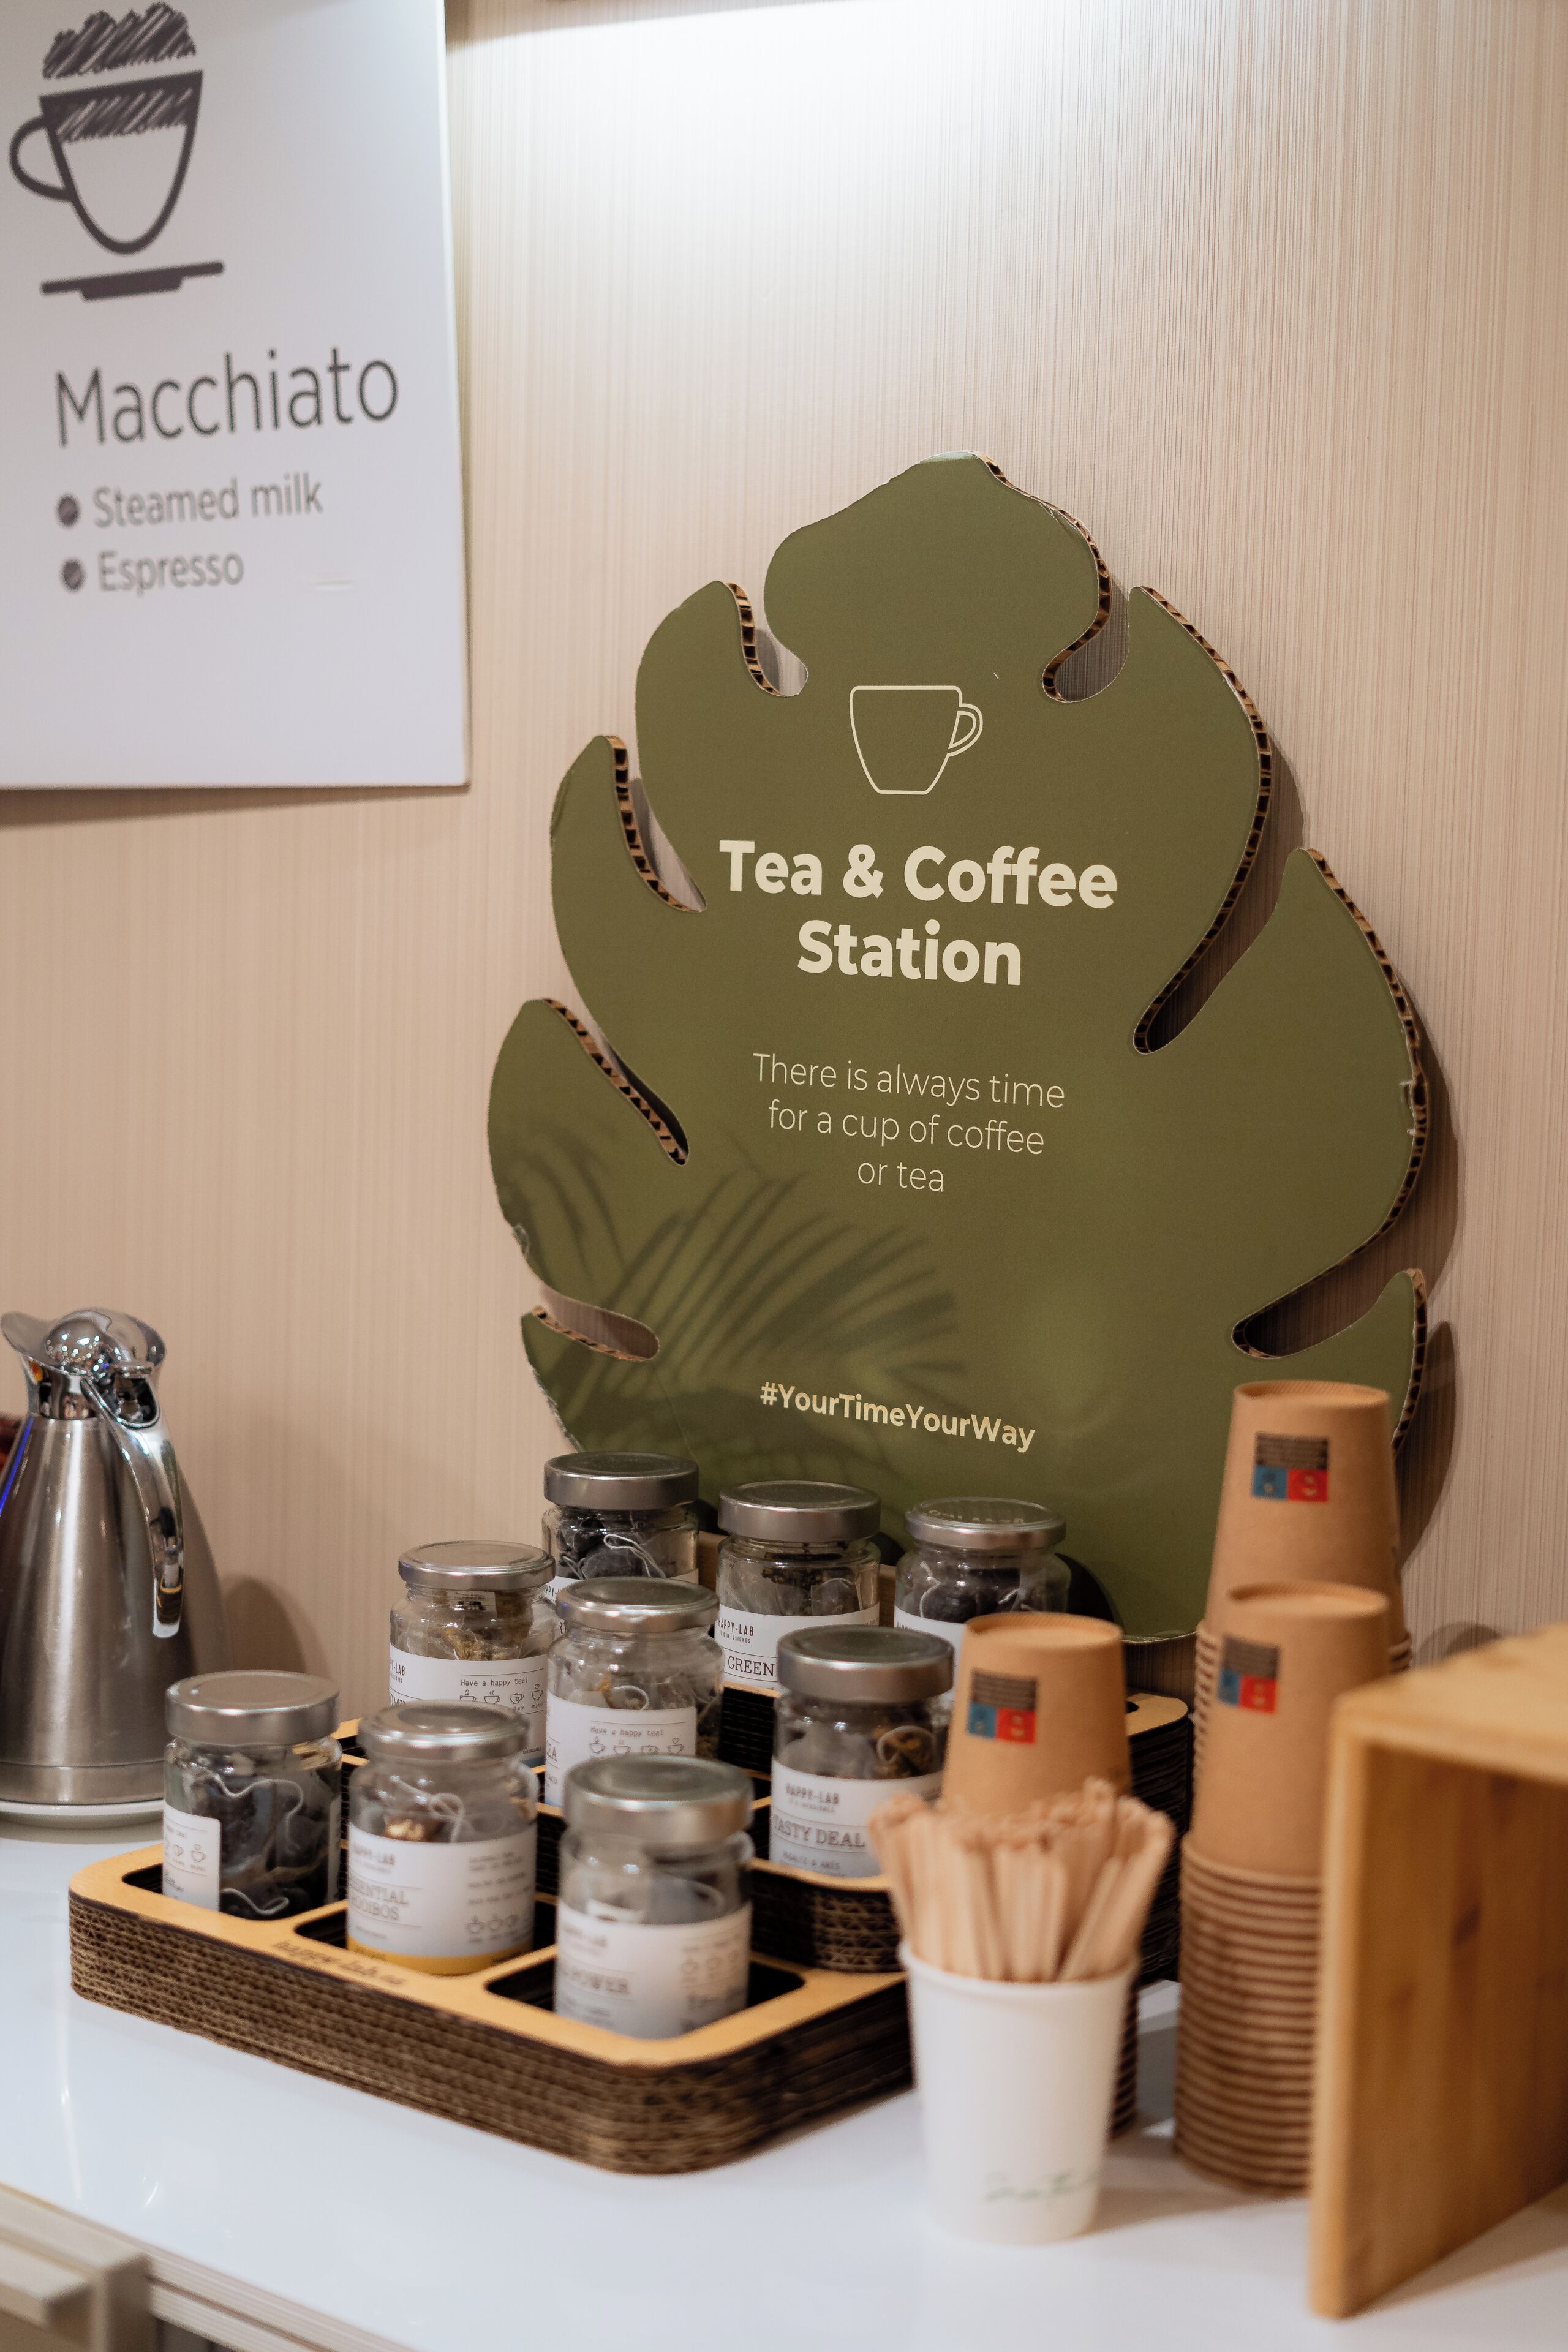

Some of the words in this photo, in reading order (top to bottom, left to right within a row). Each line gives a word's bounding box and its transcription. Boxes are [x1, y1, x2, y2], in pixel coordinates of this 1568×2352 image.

[56, 347, 399, 448] Macchiato
[93, 477, 240, 529] Steamed
[251, 472, 323, 518] milk
[97, 550, 244, 597] Espresso
[719, 839, 823, 895] Tea
[843, 843, 884, 899] &
[904, 845, 1118, 909] Coffee
[797, 919, 1021, 986] Station
[753, 1052, 837, 1088] There
[847, 1060, 867, 1091] is
[876, 1063, 980, 1107] always
[989, 1073, 1065, 1109] time
[768, 1099, 808, 1131] for
[817, 1112, 832, 1134] a
[842, 1114, 899, 1147] cup
[909, 1114, 940, 1144] of
[947, 1119, 1045, 1155] coffee
[858, 1161, 887, 1186] or
[896, 1161, 944, 1192] tea
[760, 1382, 1036, 1453] #YourTimeYourWay
[718, 1616, 754, 1637] HAPPY-LAB
[491, 1679, 511, 1687] happy
[728, 1656, 775, 1676] GREEN
[590, 1726, 608, 1735] Have
[620, 1728, 643, 1738] happy
[774, 1814, 812, 1841] TASTY
[816, 1827, 865, 1848] DEAL
